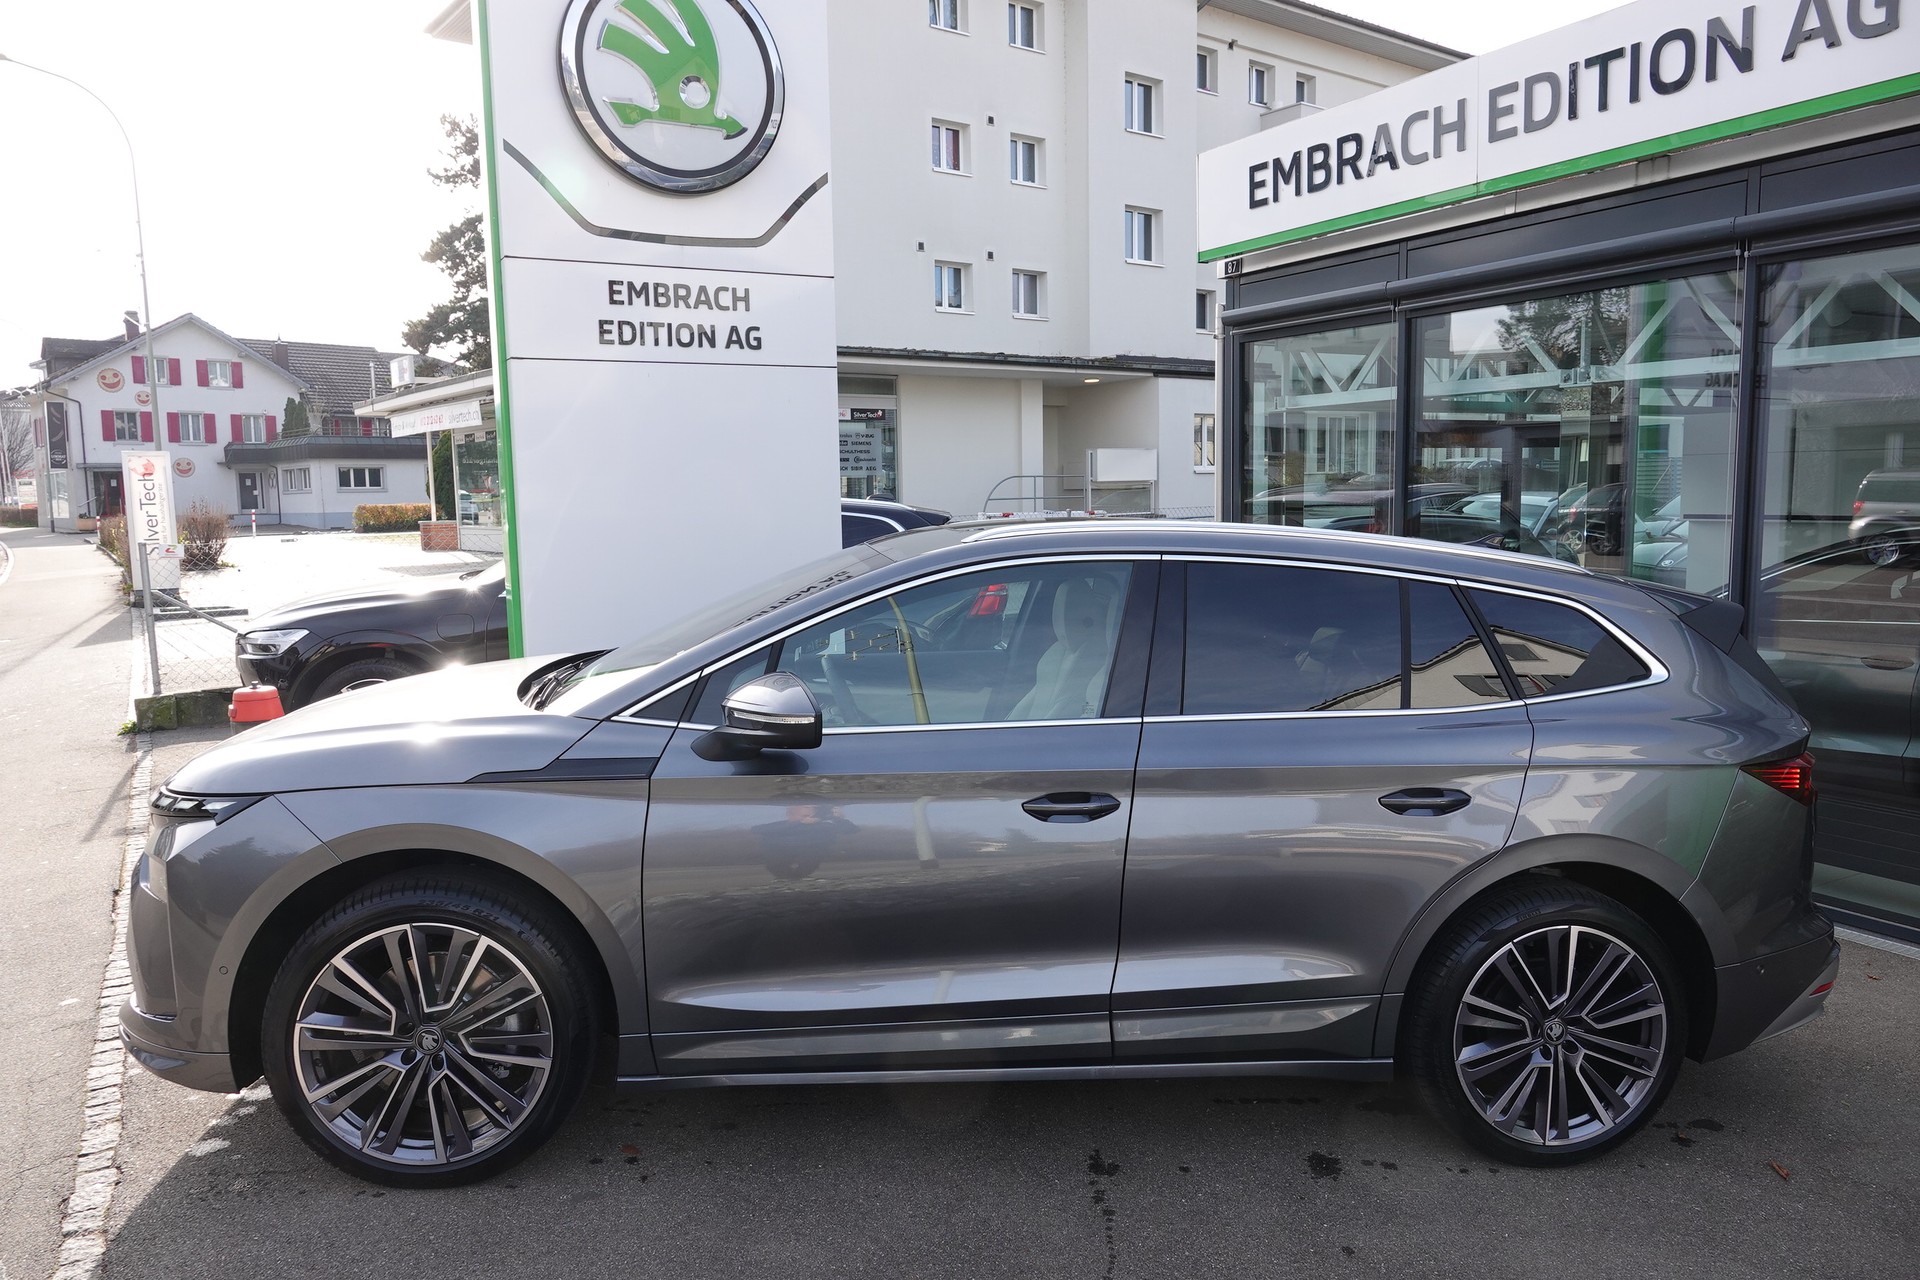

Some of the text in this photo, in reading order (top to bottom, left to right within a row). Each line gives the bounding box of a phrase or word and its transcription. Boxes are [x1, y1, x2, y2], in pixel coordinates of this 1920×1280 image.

[1247, 0, 1901, 210] EMBRACH EDITION AG
[1227, 261, 1237, 274] 87
[608, 279, 751, 312] EMBRACH
[598, 319, 763, 351] EDITION AG
